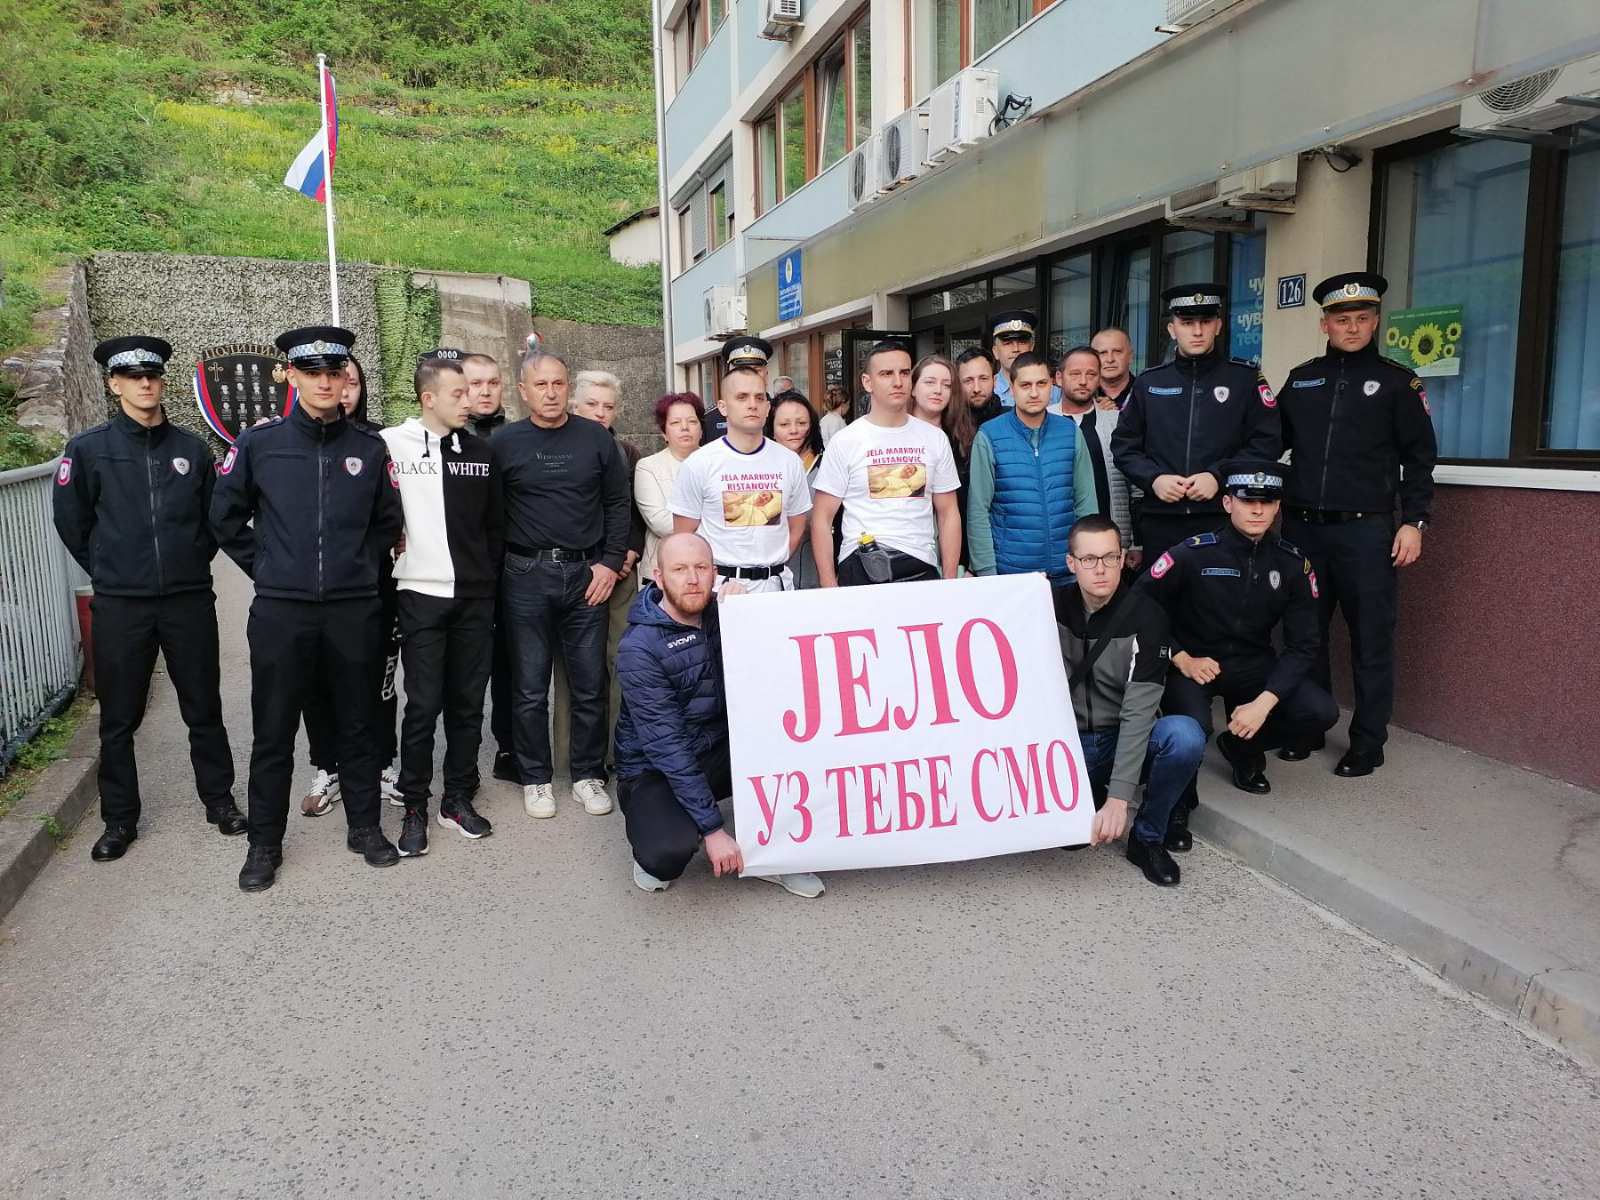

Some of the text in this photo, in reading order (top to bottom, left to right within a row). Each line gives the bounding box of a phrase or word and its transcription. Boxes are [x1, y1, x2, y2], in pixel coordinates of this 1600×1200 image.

[1281, 280, 1301, 304] 126
[865, 449, 884, 458] JELA
[447, 462, 490, 477] WHITE
[721, 473, 739, 482] JELA
[782, 617, 1018, 743] ЈЕЛО
[748, 739, 1080, 847] УЗ ТЕБЕ СМО
